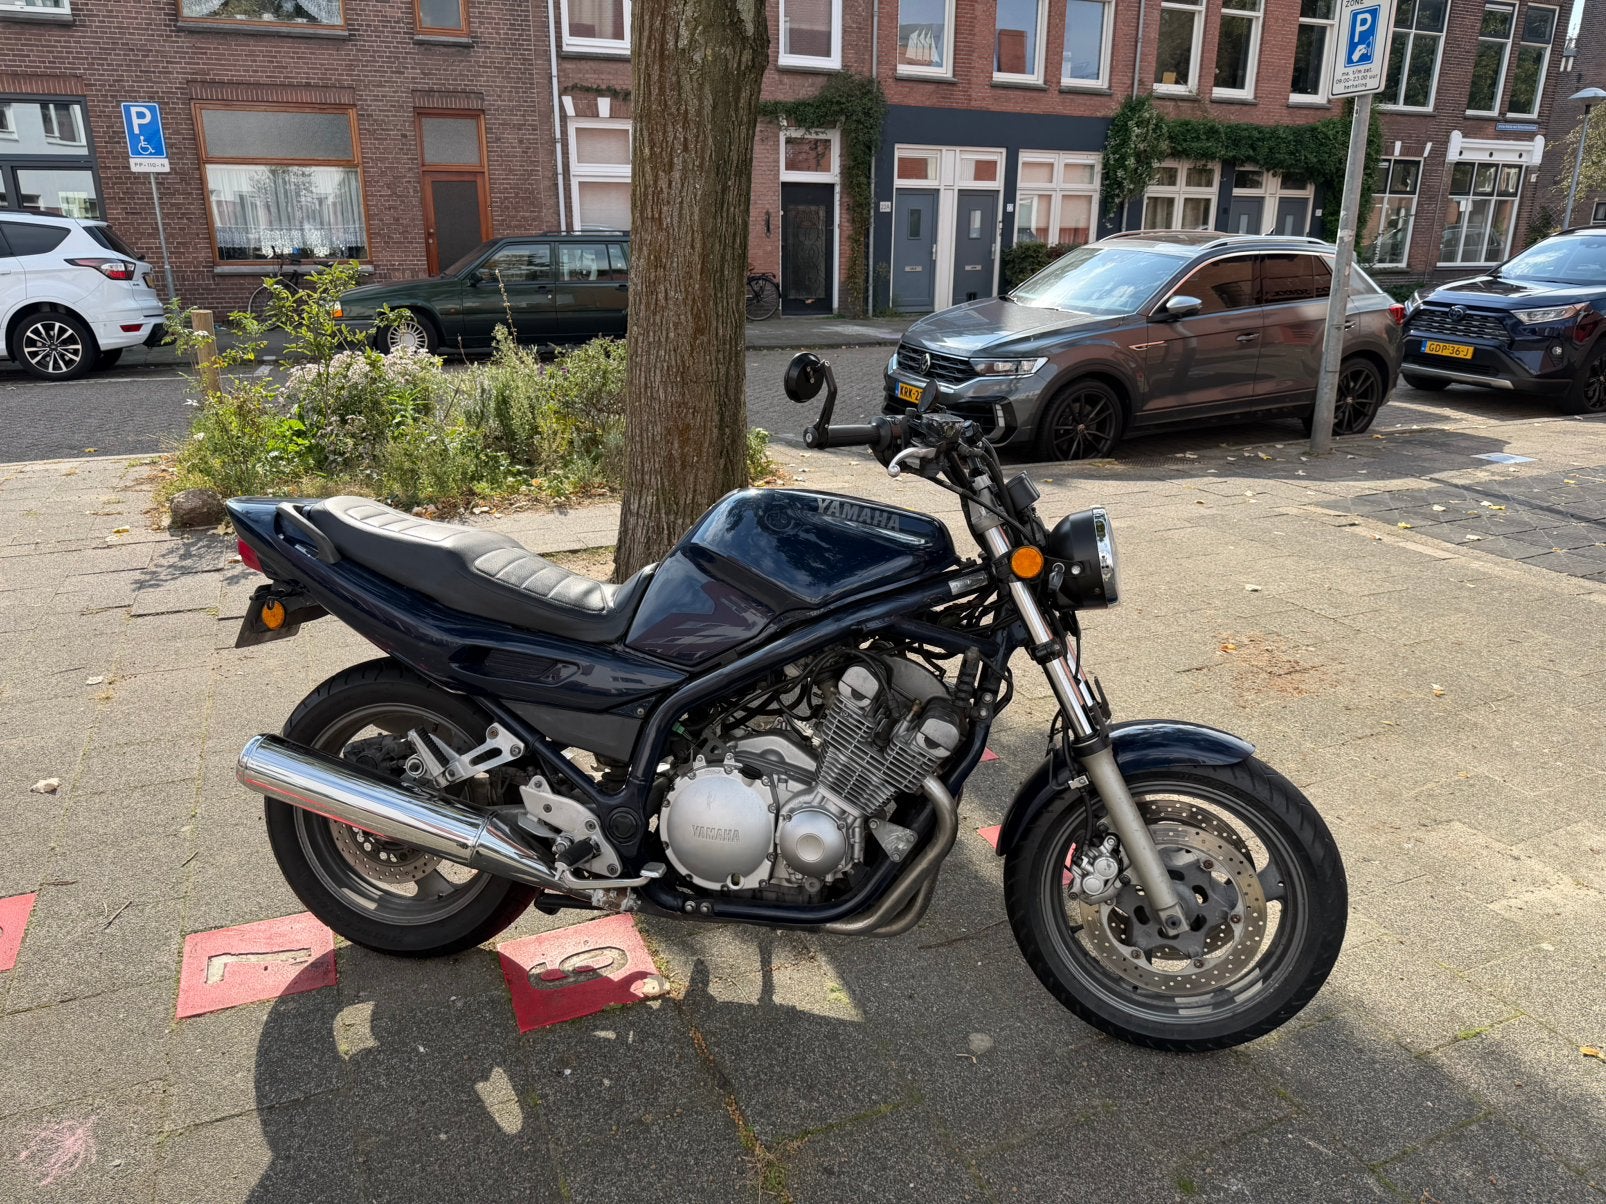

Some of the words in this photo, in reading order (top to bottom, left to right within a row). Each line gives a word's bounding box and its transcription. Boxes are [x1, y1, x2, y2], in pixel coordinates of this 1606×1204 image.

[1354, 13, 1372, 42] P
[130, 106, 151, 134] P
[1428, 343, 1469, 356] GDP-36-J
[816, 498, 900, 532] YAMAHA
[690, 824, 742, 844] YAMAHA
